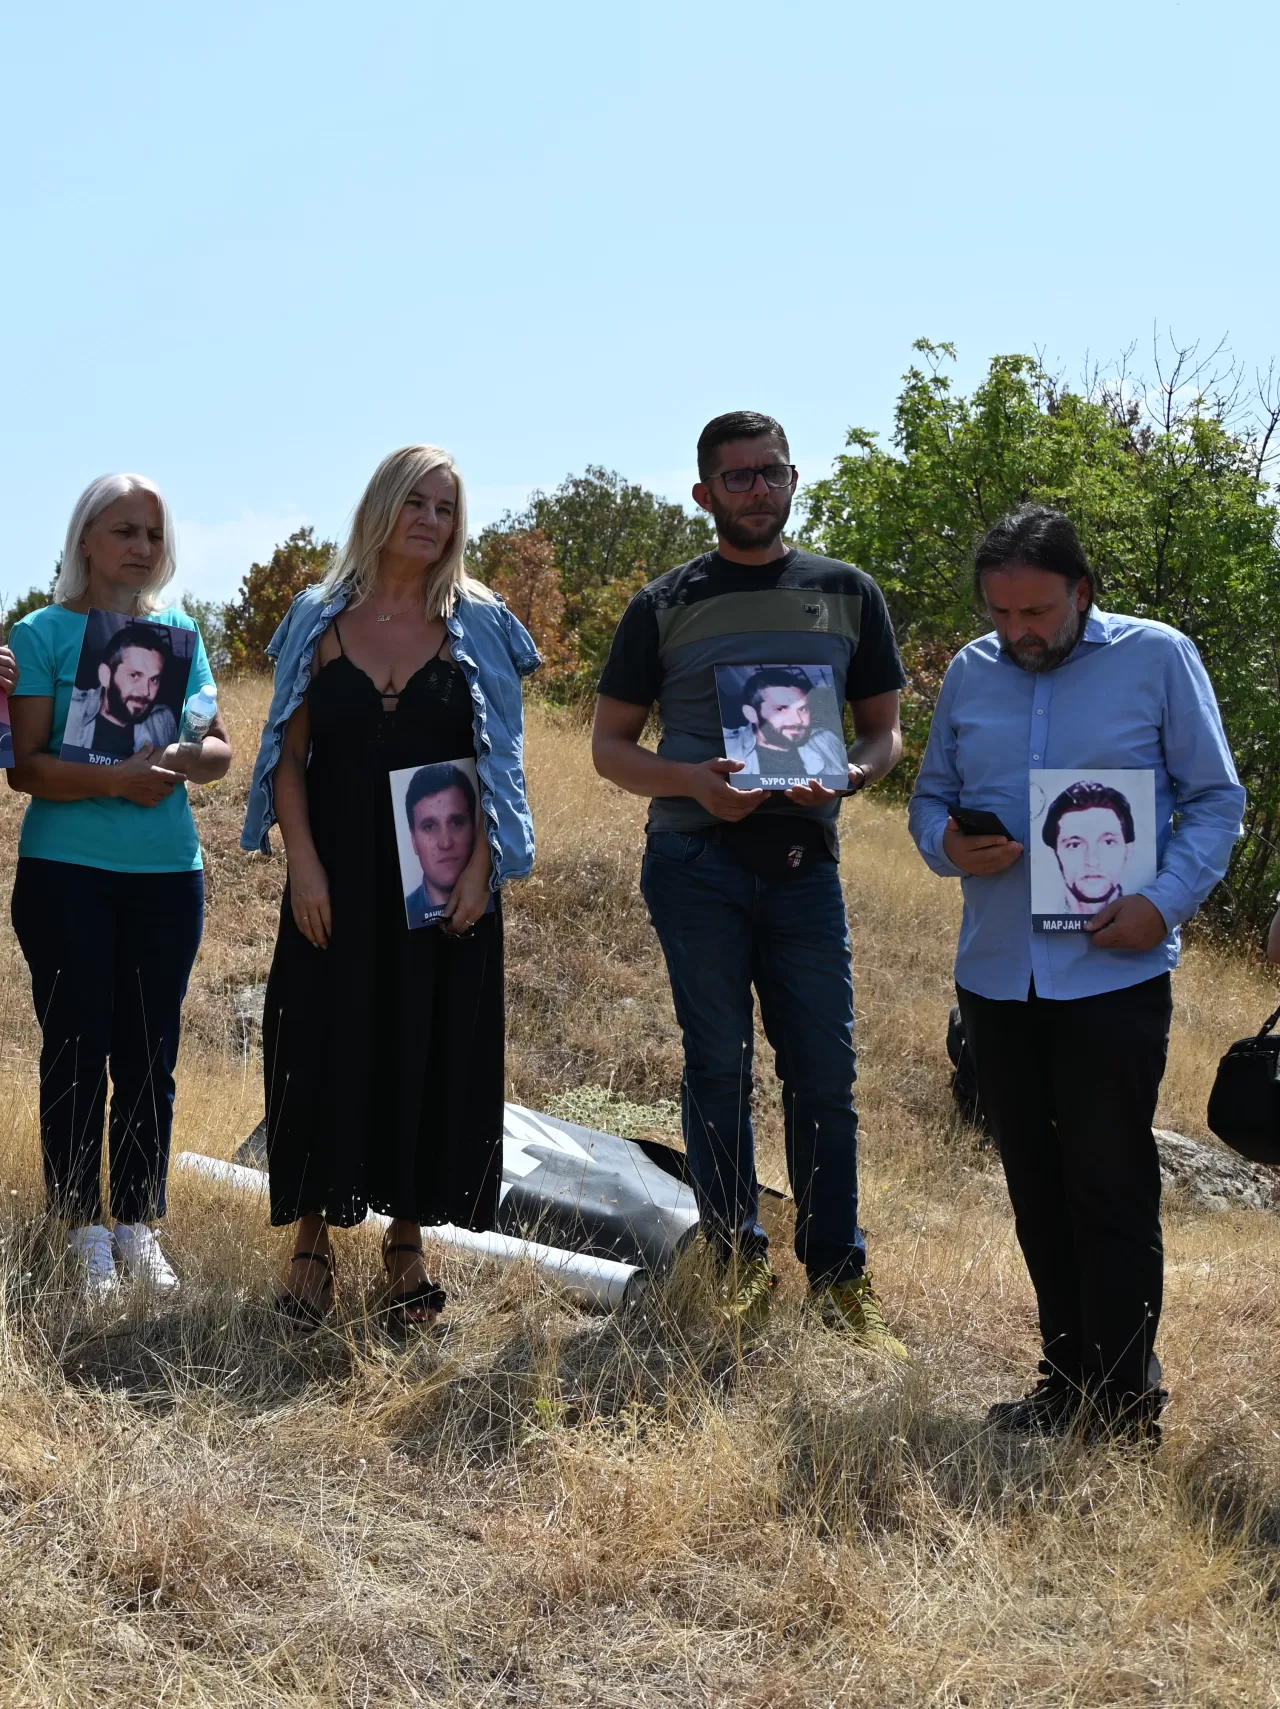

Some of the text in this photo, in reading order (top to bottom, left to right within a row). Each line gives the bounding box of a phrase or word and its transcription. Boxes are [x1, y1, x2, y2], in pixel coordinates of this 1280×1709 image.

[89, 753, 112, 765] ЂУРО
[760, 777, 823, 786] ЂУРО СЛАЈ
[1043, 920, 1081, 930] МАРЈАН
